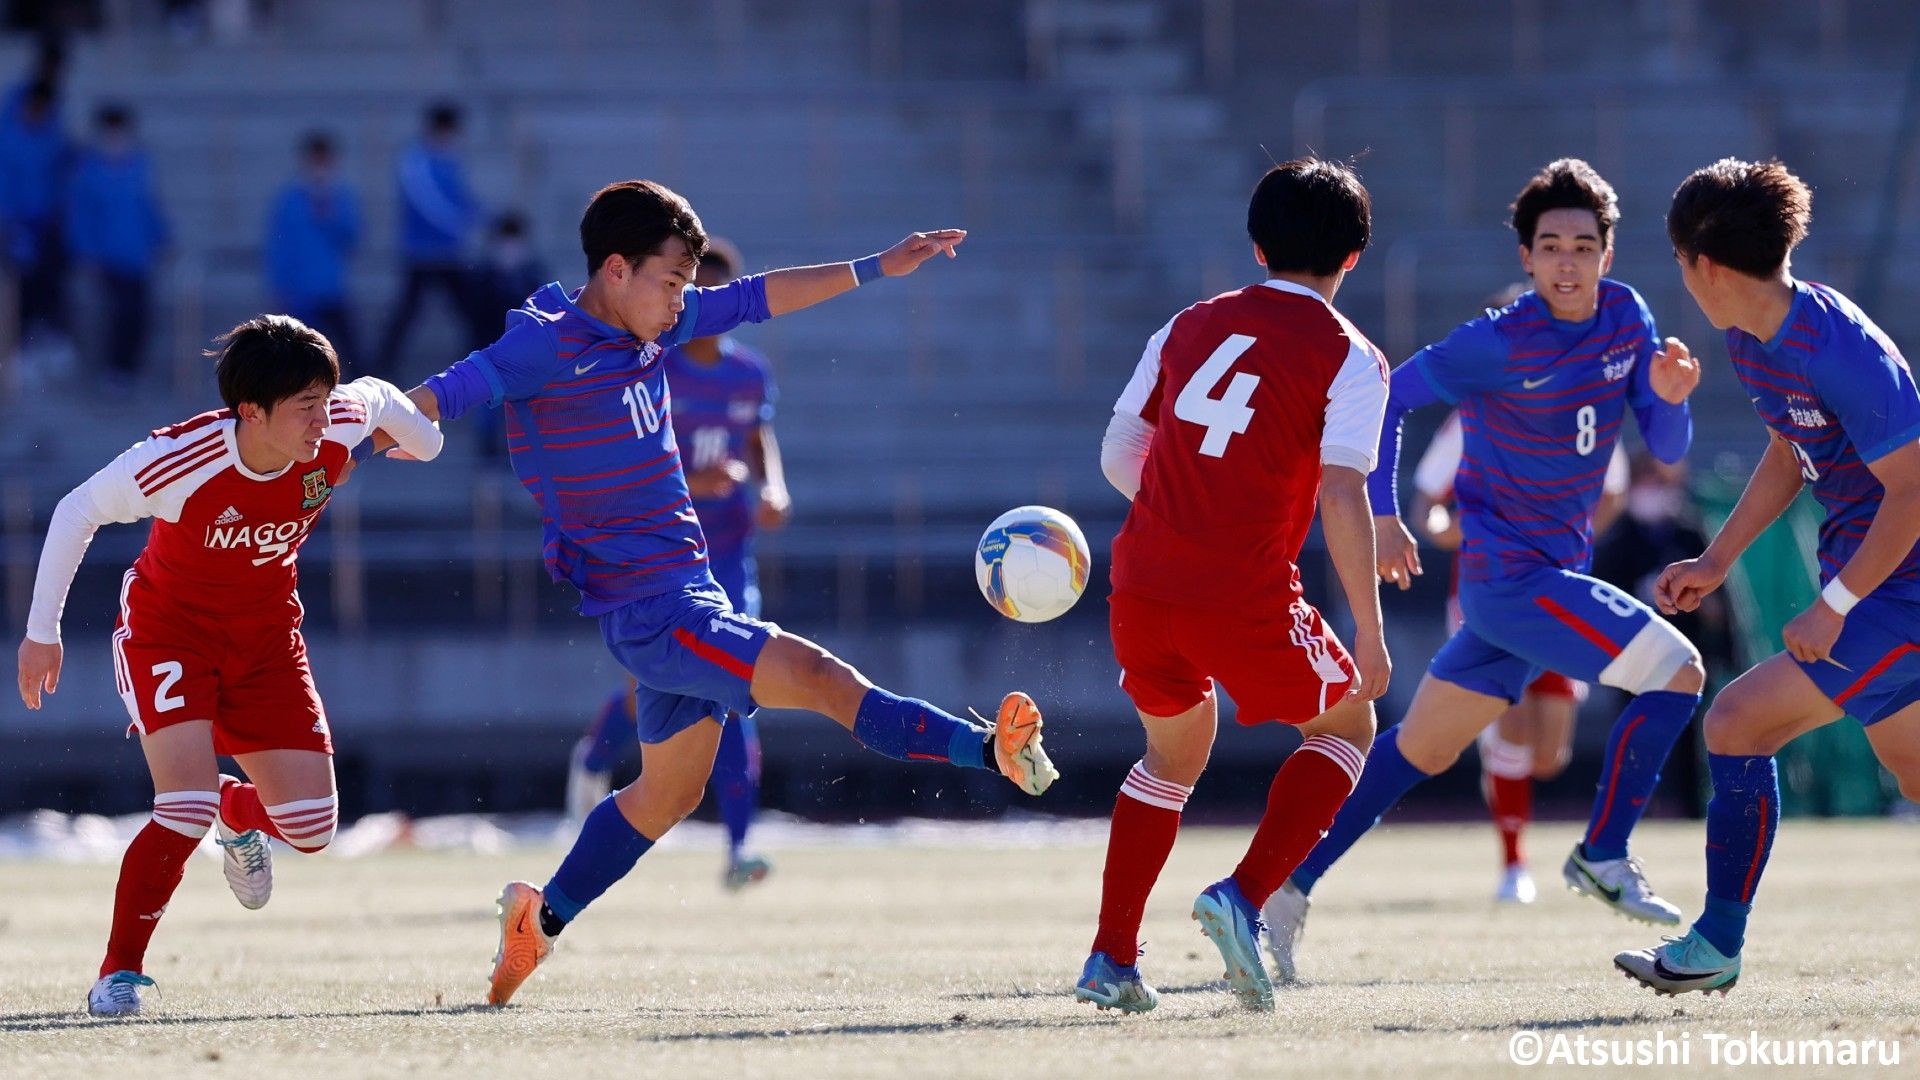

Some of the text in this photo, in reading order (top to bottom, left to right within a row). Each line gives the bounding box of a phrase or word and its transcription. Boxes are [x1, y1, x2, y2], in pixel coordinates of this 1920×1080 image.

[622, 381, 660, 439] 10
[1174, 333, 1261, 459] 4
[1576, 405, 1597, 456] 8
[214, 514, 244, 526] adidas
[1590, 583, 1638, 617] 8
[152, 661, 185, 713] 2
